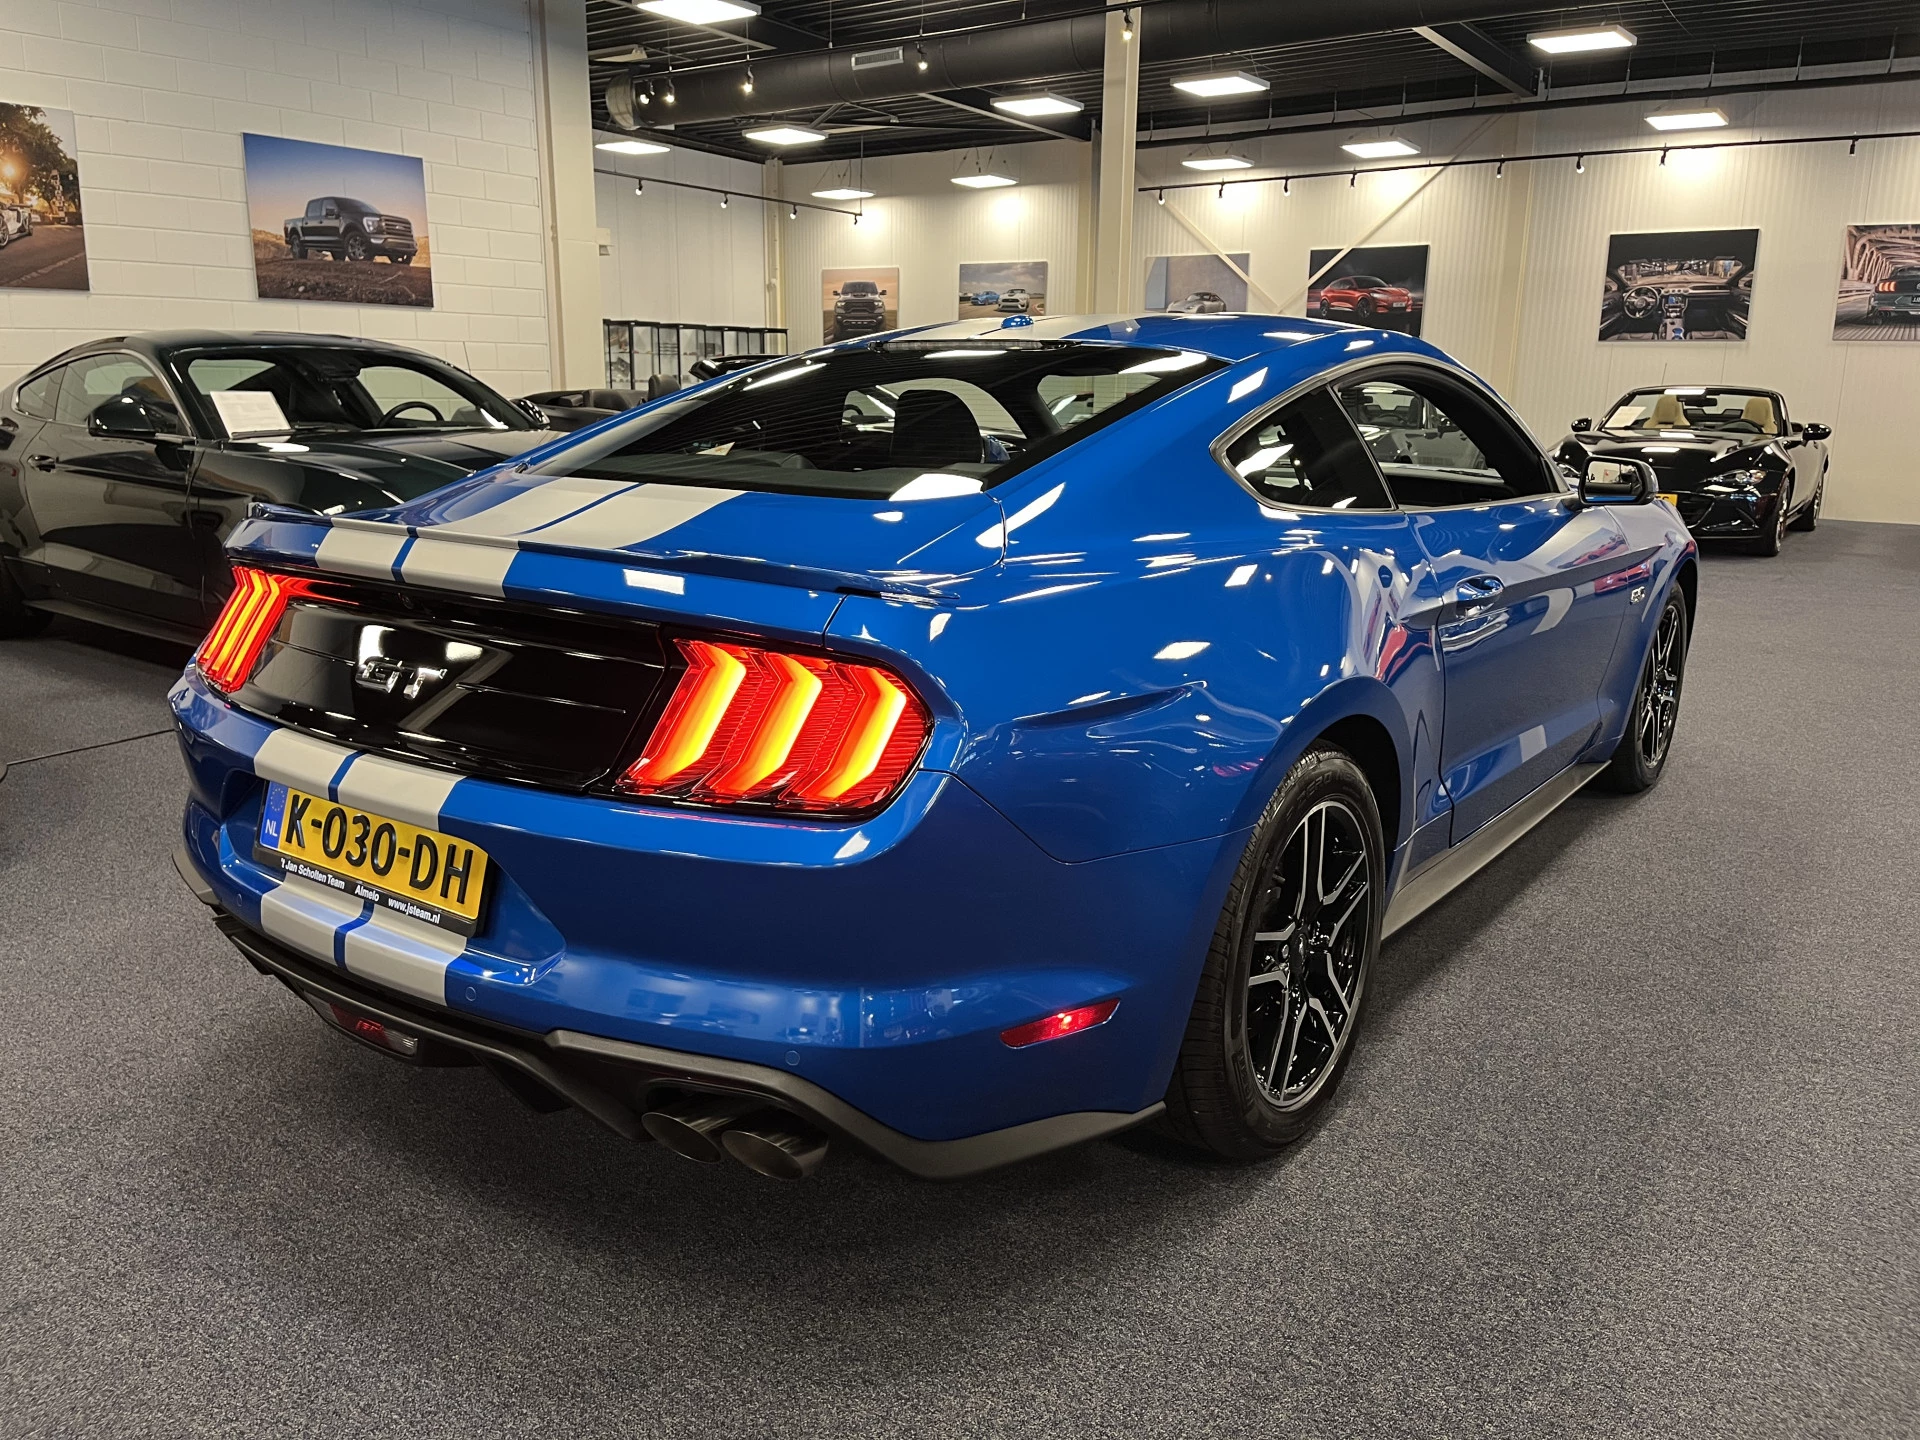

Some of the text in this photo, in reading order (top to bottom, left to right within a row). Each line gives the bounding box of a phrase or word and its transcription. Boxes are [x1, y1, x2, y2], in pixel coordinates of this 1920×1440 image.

[355, 656, 448, 699] GT
[265, 818, 279, 838] NL
[285, 793, 474, 905] K-030-DH
[285, 860, 298, 873] Jan
[298, 864, 327, 883] Scholten
[327, 873, 345, 890] Team
[354, 884, 380, 902] Almelo
[388, 897, 441, 924] www.jsteam.nl
